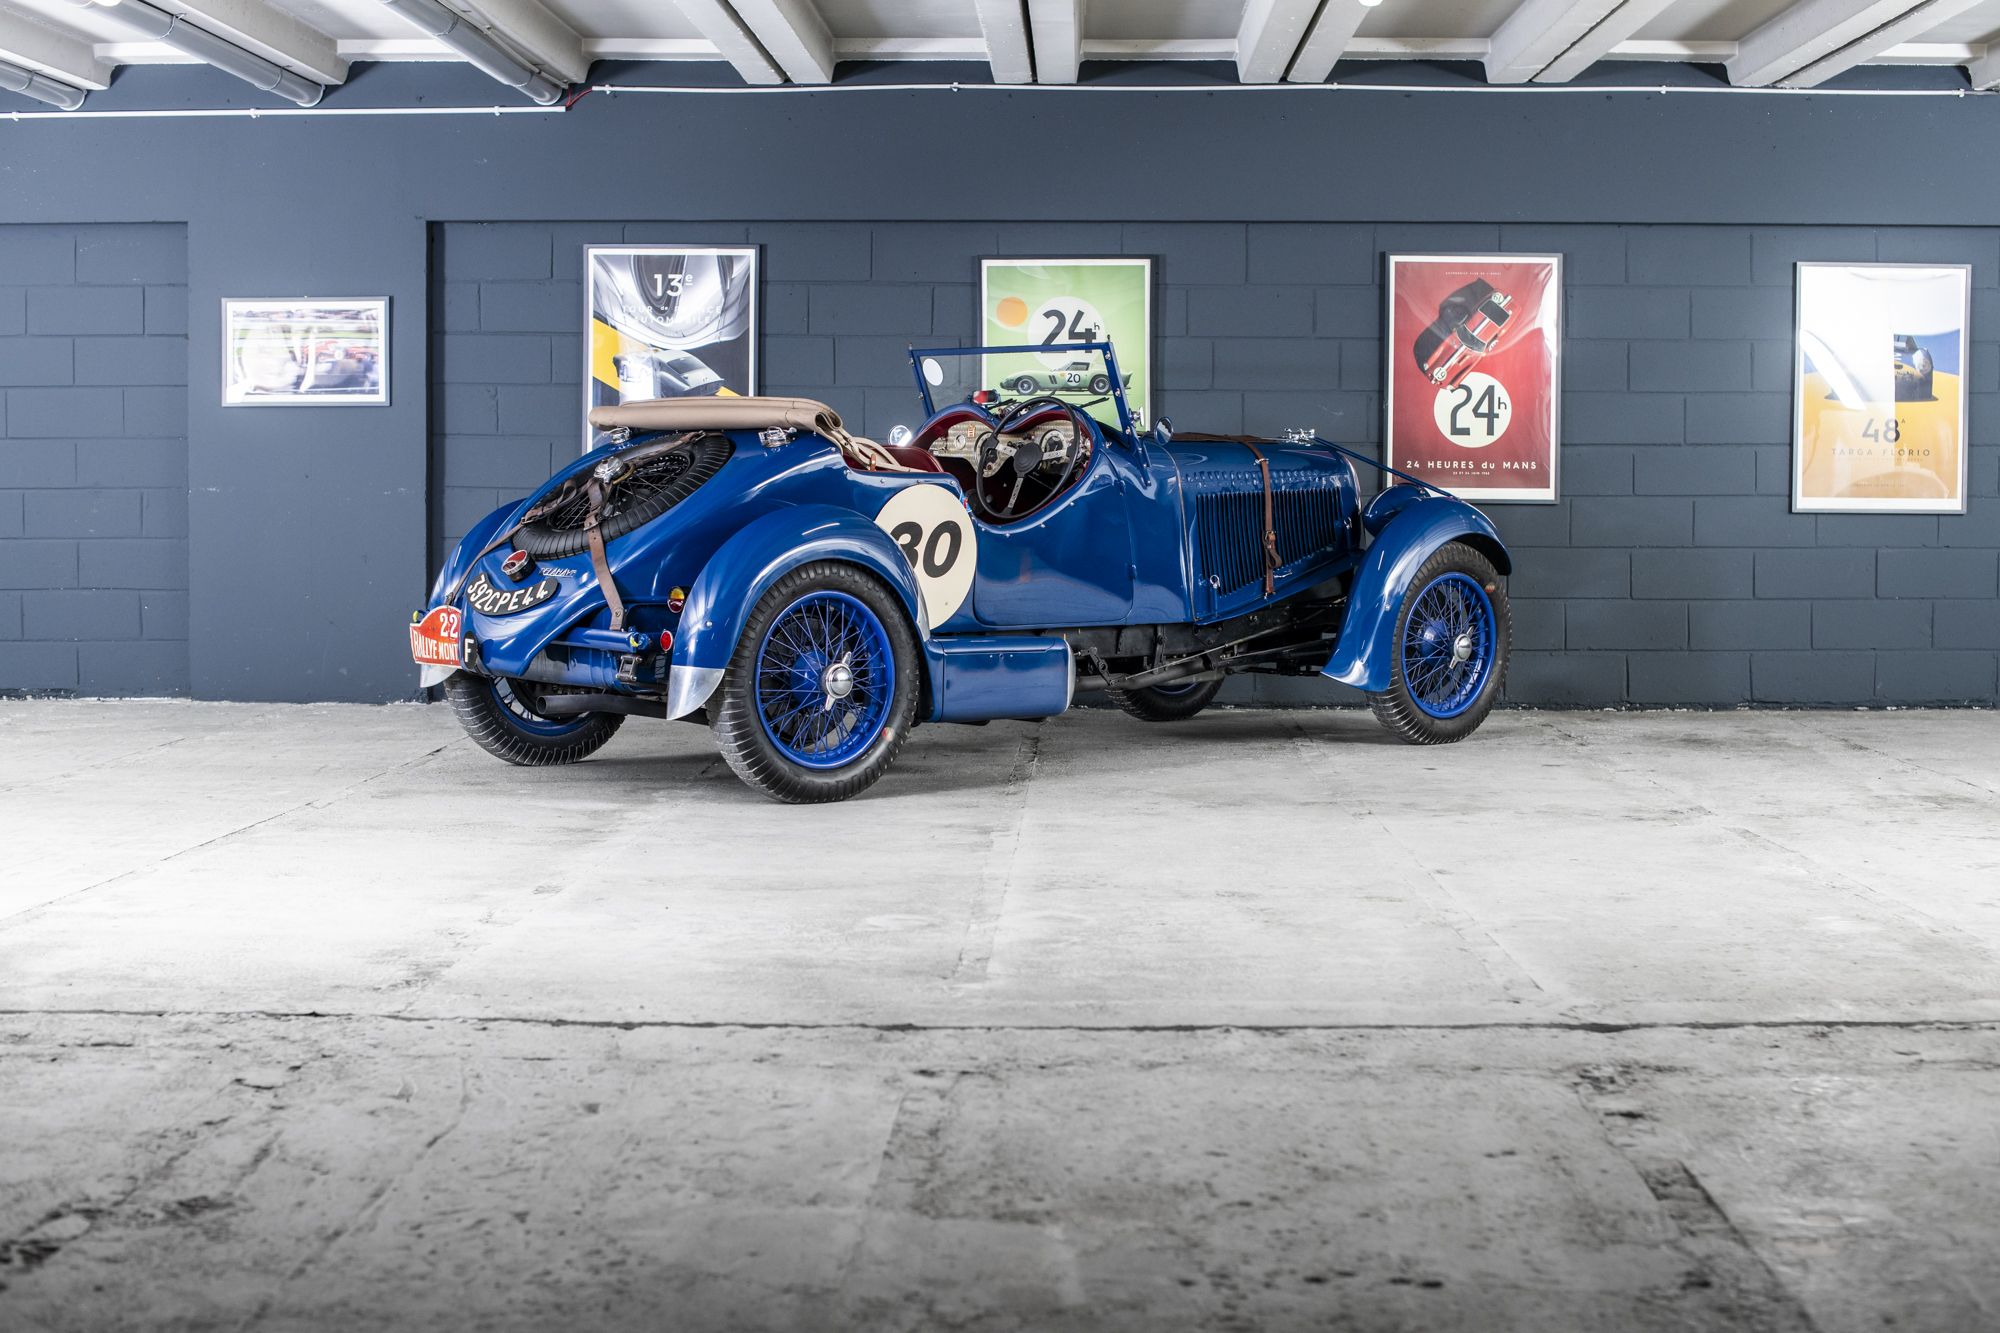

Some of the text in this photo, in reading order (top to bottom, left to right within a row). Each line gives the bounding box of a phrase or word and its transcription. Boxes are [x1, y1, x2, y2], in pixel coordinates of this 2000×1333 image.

[674, 305, 722, 313] FCE
[632, 316, 711, 324] UTOMILE
[1066, 373, 1081, 384] 20
[1831, 448, 1931, 456] TARGA FLORIO
[1406, 460, 1537, 470] 24 HEURES du MANS
[439, 612, 458, 638] 22
[413, 629, 438, 660] RALLYE
[464, 638, 475, 662] F
